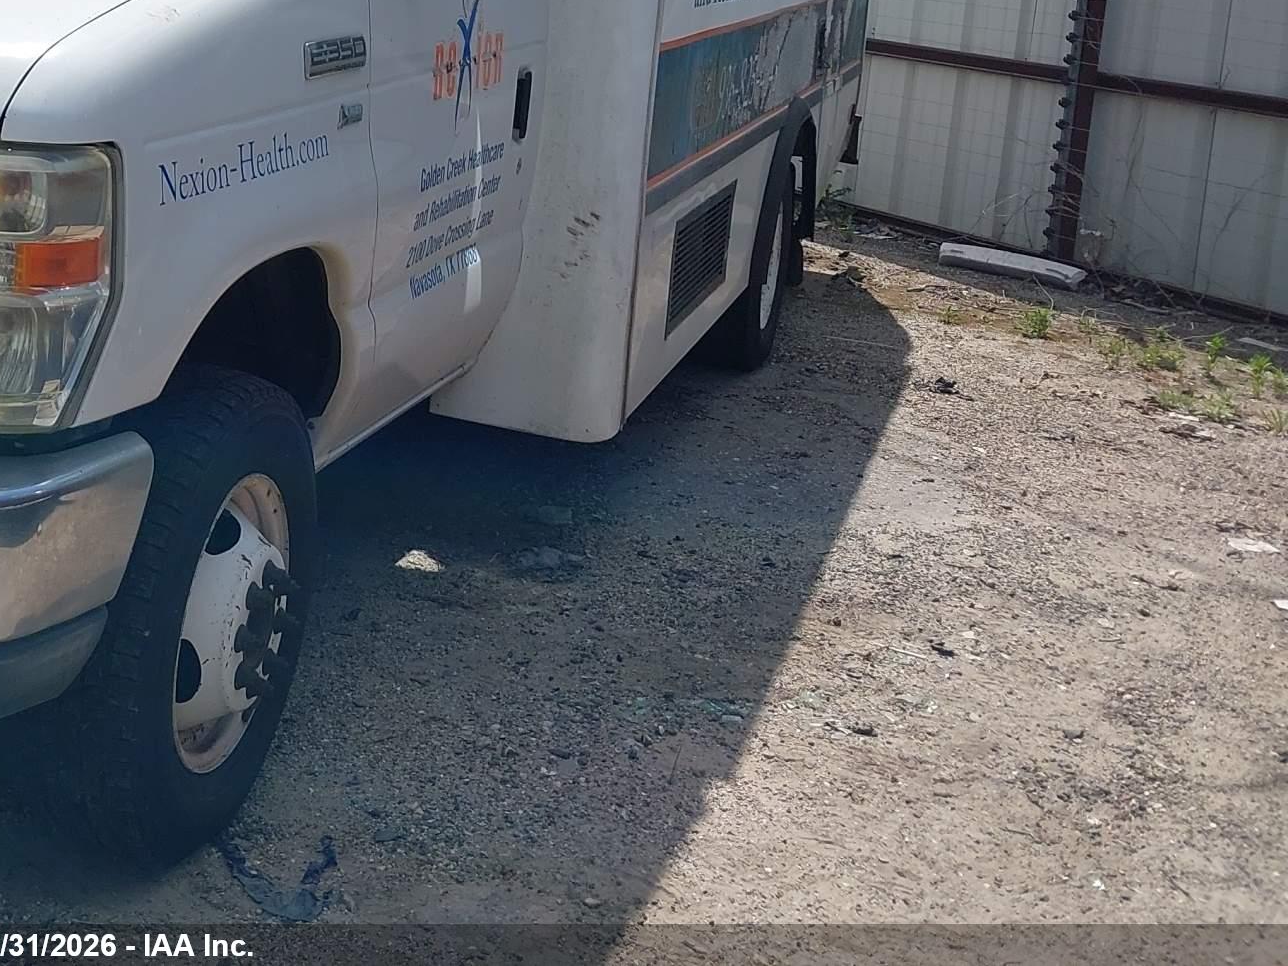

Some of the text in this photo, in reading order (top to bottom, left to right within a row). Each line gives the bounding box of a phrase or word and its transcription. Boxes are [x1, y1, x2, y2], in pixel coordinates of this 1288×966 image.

[159, 132, 329, 206] Nexion-Health.com
[420, 142, 505, 193] Golden Creek Healthcare
[413, 175, 502, 232] and Rehabilitation Center
[406, 238, 428, 269] 2100
[475, 209, 495, 231] Lane
[410, 262, 446, 300] Navasota,
[445, 252, 457, 277] TX
